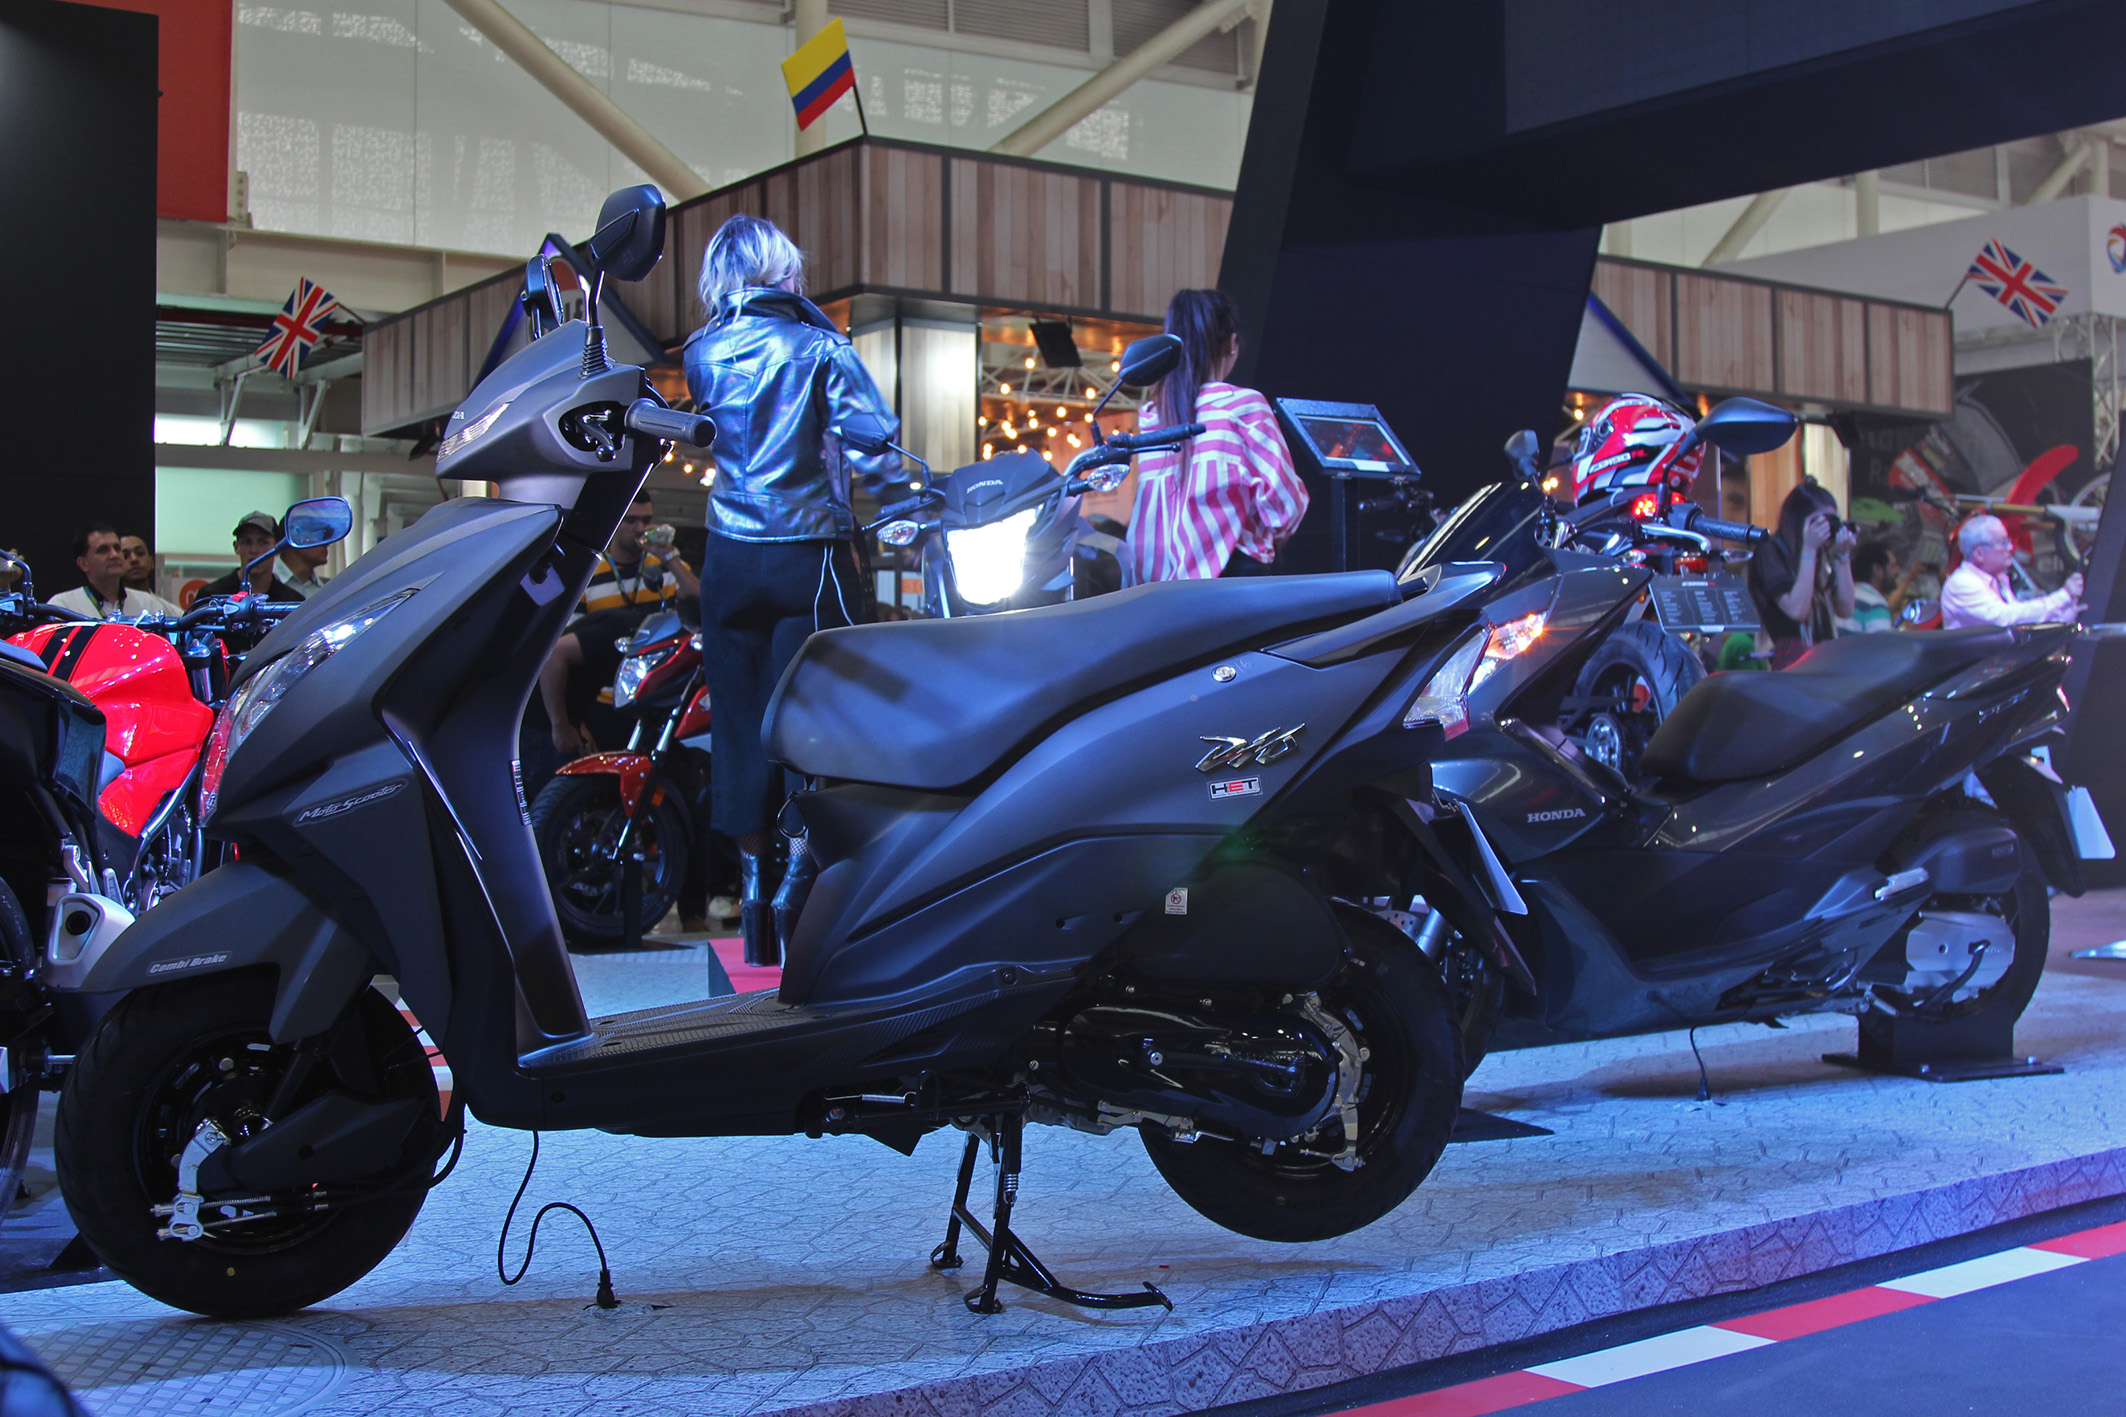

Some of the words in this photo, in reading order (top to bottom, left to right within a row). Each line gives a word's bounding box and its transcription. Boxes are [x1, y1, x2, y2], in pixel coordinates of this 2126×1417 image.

[966, 479, 1004, 494] HONDA
[1211, 779, 1258, 795] HET
[299, 803, 341, 821] Moto
[342, 784, 403, 811] Scooter
[1527, 807, 1587, 824] HONDA
[149, 959, 191, 974] Combi
[189, 954, 227, 967] Brake
